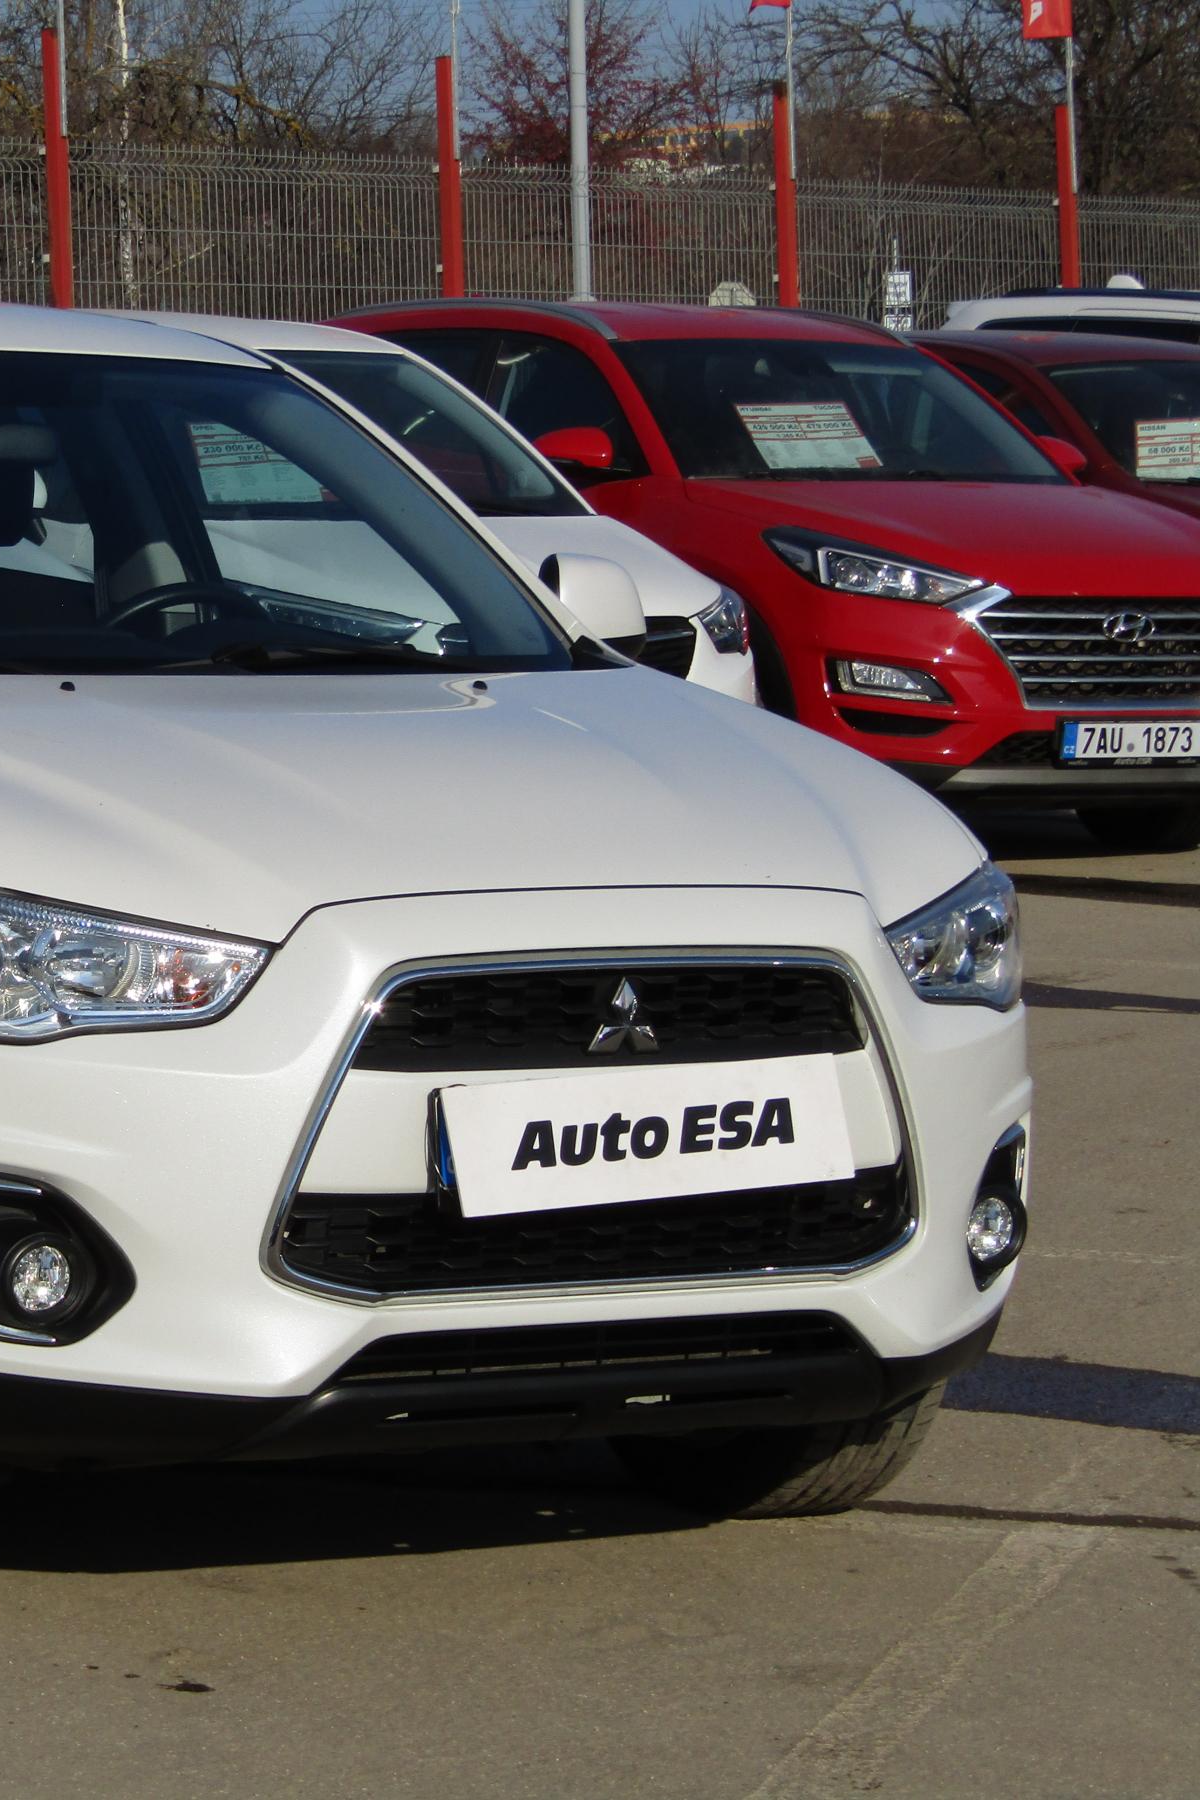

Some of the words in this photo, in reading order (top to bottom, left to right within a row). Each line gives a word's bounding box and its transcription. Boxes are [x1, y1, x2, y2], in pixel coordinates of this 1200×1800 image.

[1160, 446, 1176, 454] 000
[1082, 727, 1123, 754] 7AU
[1143, 726, 1193, 753] 1873
[1063, 745, 1075, 754] CZ
[511, 1112, 669, 1171] Auto
[679, 1097, 795, 1155] ESA
